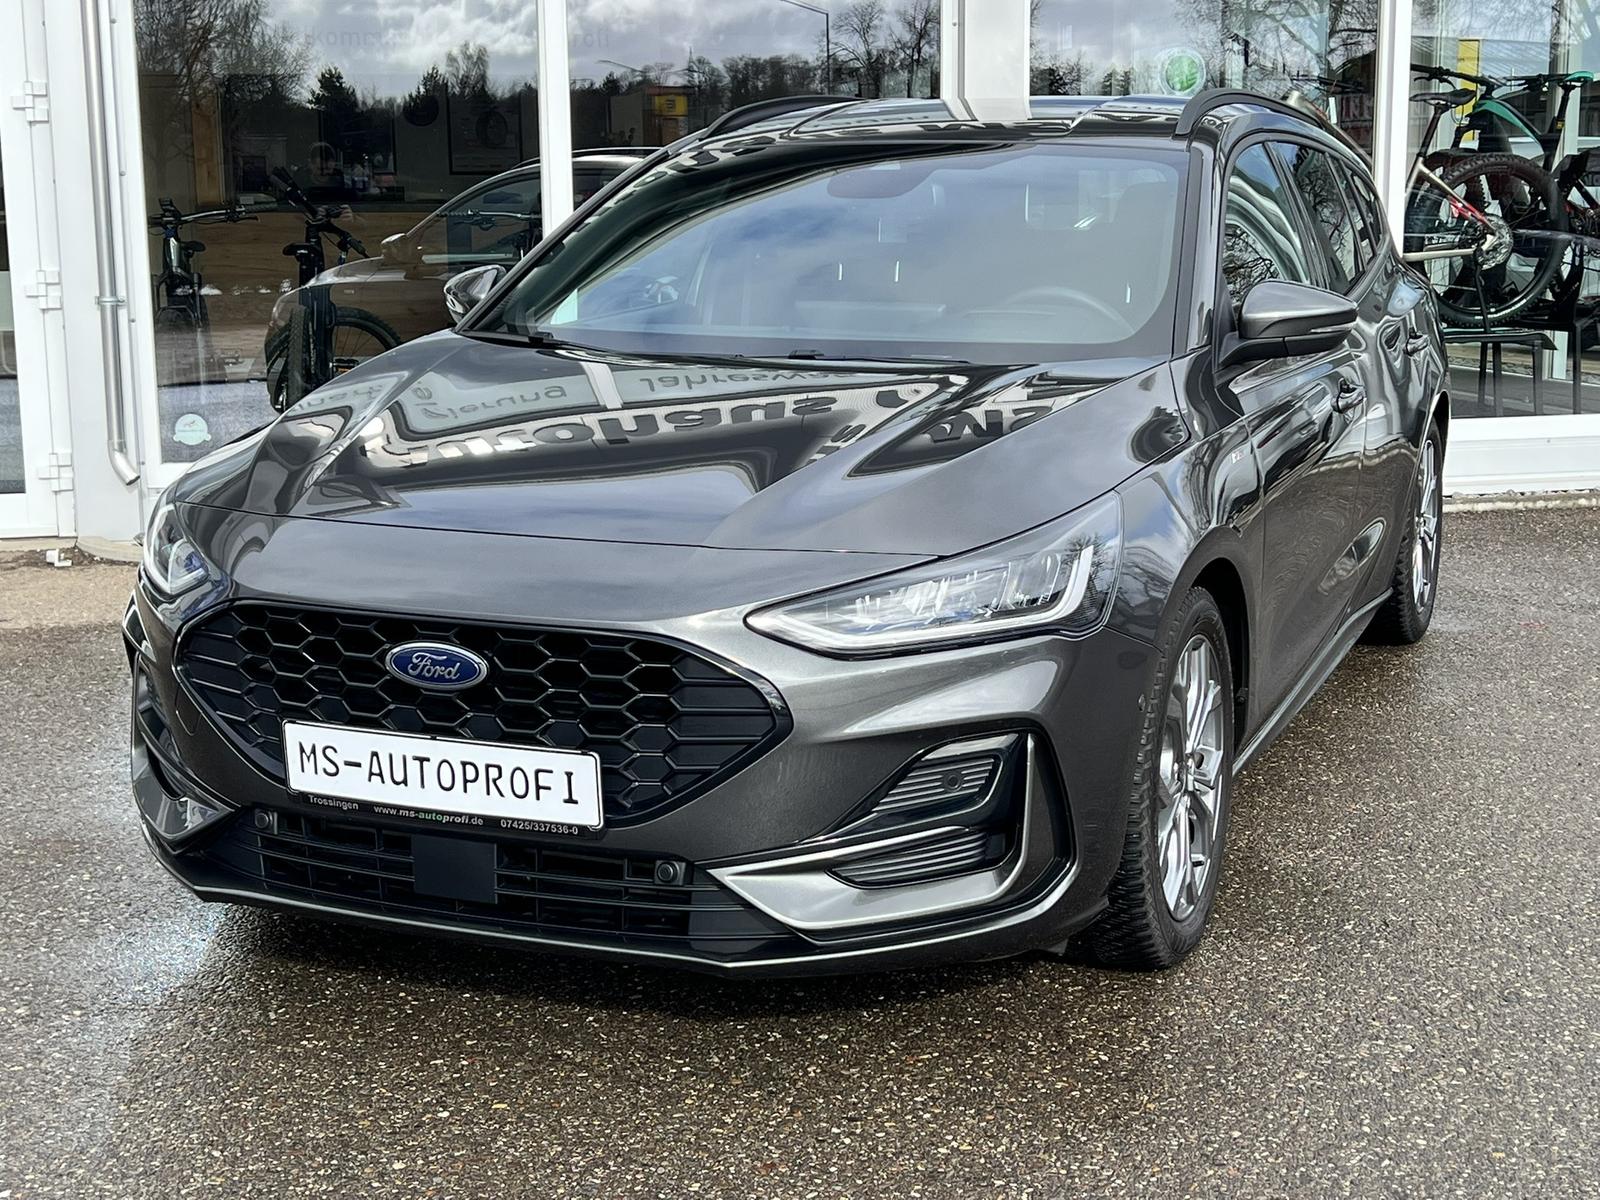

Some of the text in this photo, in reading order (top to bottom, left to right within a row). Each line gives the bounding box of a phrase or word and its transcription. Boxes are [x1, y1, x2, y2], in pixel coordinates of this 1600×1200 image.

[407, 651, 461, 680] Ford
[298, 741, 579, 805] MS-AUTOPROFI
[308, 794, 579, 835] Trossingen www.ms-autoprofi.de 07425/337536-0
